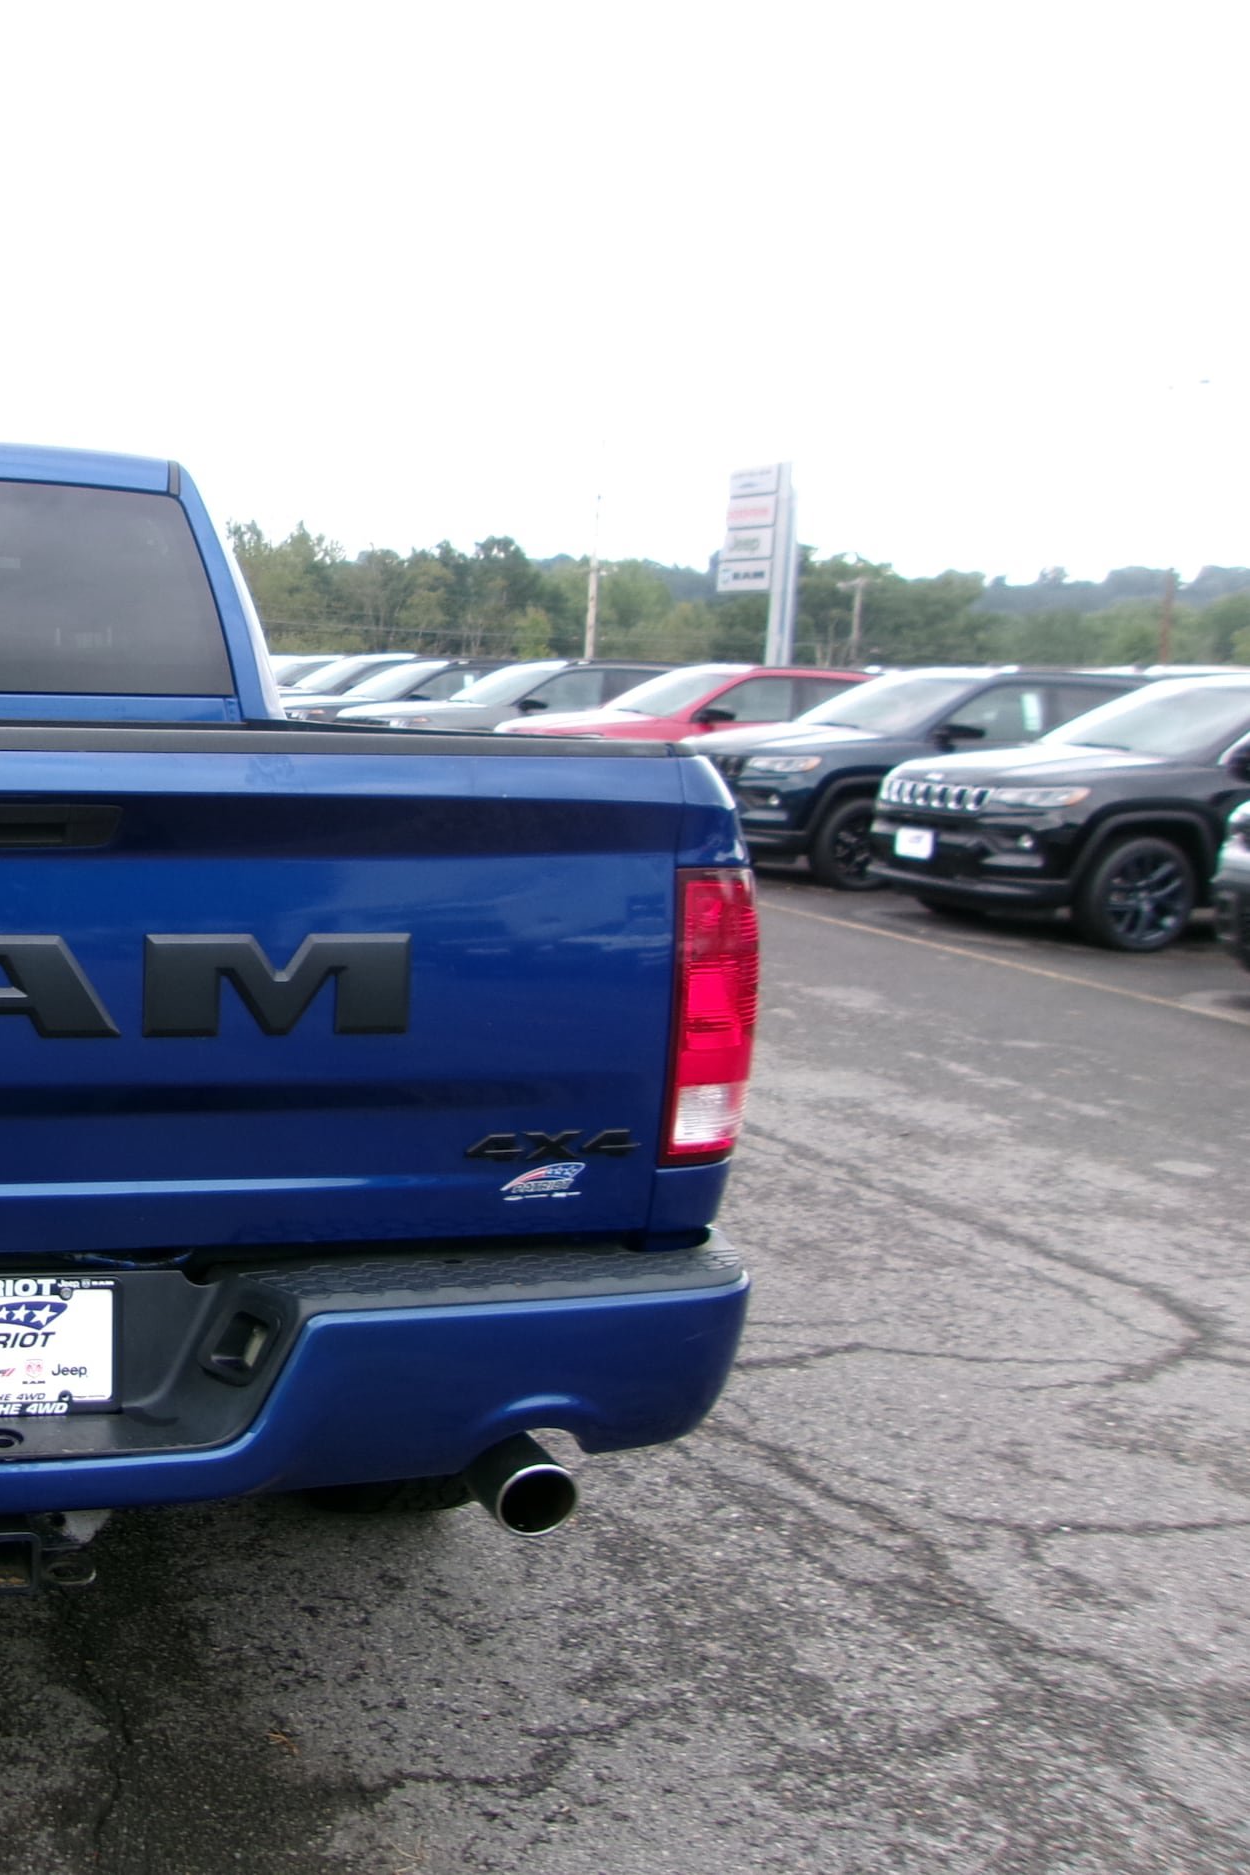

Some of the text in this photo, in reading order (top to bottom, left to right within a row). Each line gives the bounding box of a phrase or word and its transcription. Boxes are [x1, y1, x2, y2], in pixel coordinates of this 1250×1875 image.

[51, 1363, 88, 1378] Jeep
[16, 1392, 46, 1400] 4WD
[25, 1402, 68, 1414] 4WD
